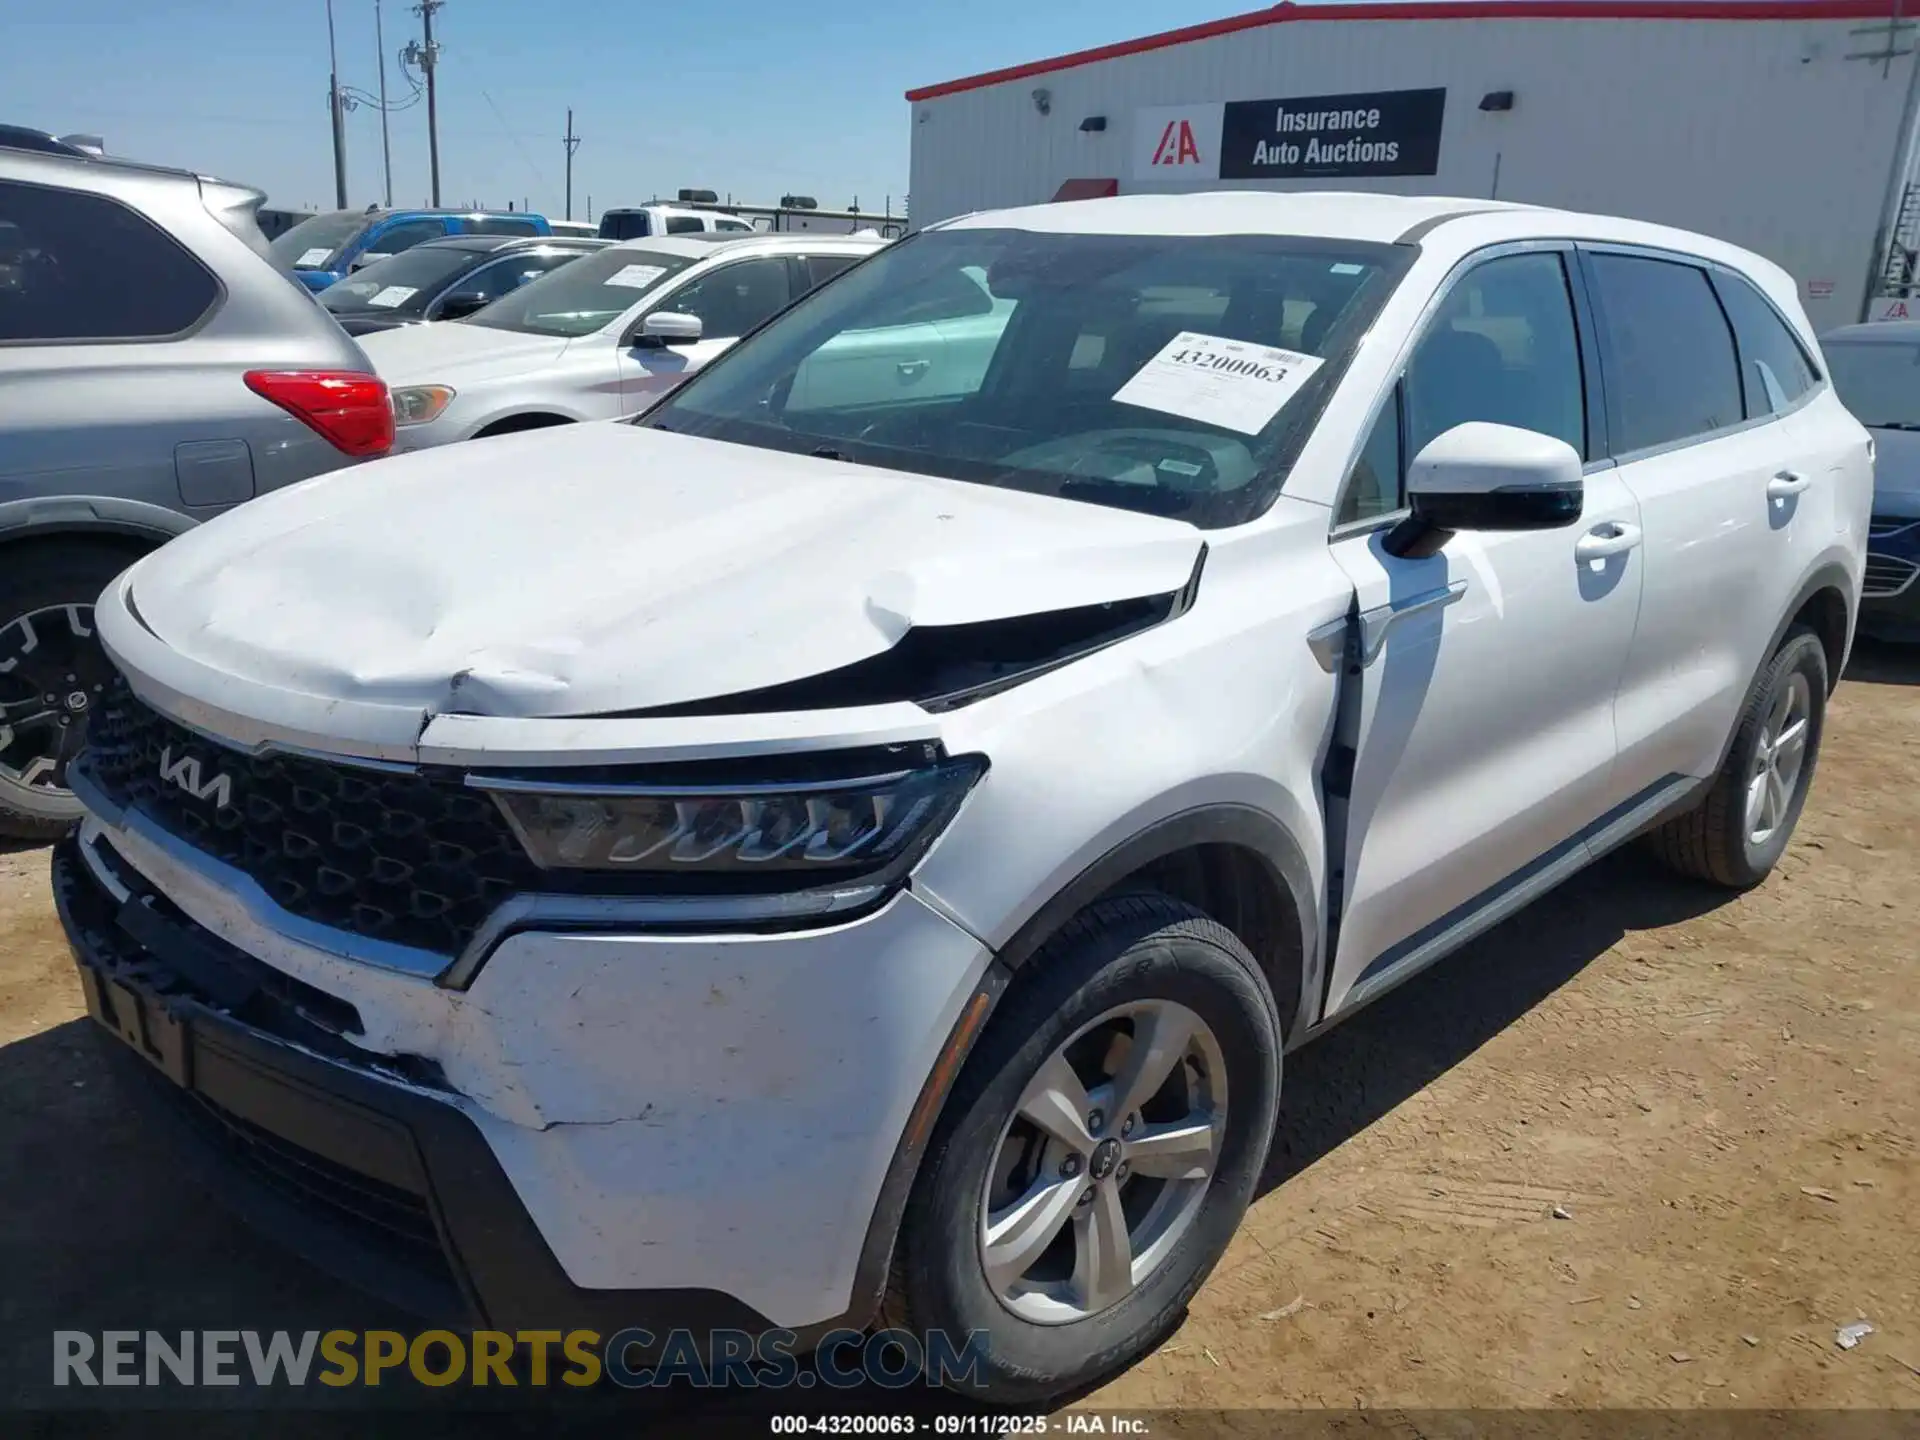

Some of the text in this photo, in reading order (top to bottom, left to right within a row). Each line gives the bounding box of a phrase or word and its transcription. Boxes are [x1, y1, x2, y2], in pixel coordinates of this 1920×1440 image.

[1276, 107, 1380, 132] Insurance
[1253, 137, 1399, 165] Auto Auctions
[1171, 348, 1288, 383] 43200063
[160, 746, 231, 809] KIA
